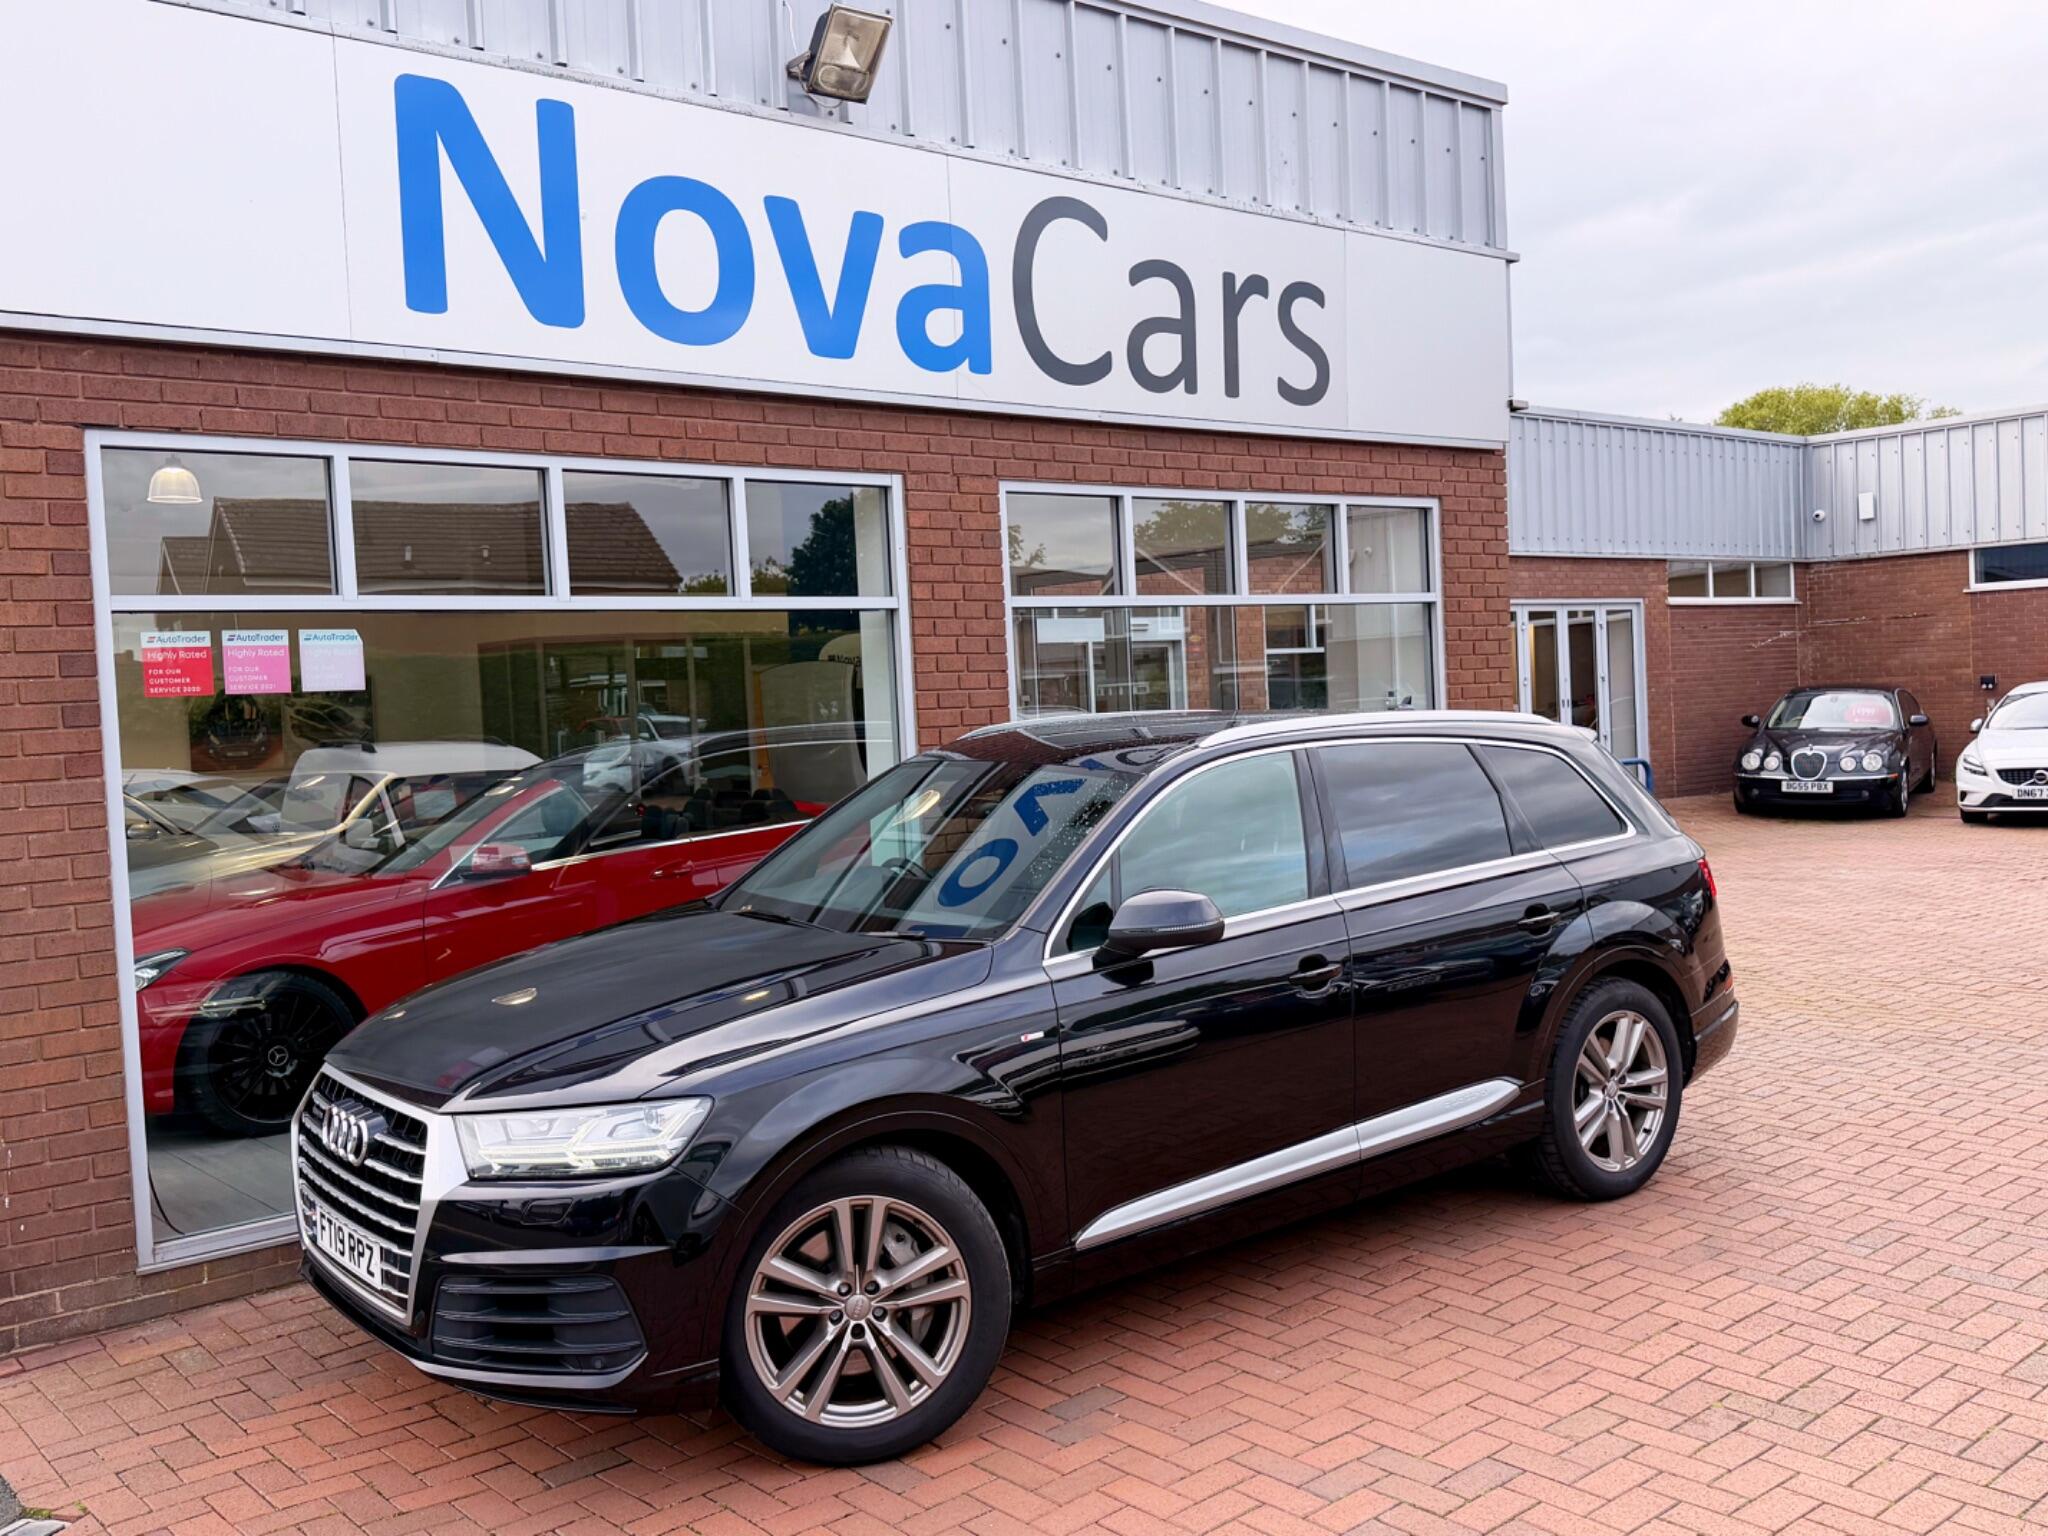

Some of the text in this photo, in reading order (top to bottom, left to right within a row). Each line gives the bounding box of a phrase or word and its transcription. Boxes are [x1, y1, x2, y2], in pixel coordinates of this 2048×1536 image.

[394, 73, 1330, 407] NovaCars
[156, 634, 206, 644] AutoTrader
[236, 633, 284, 642] AutoTrader
[312, 633, 358, 641] AutoTrader
[147, 650, 207, 661] Highly Rated
[227, 647, 285, 659] Highly Rated
[148, 677, 191, 685] CUSTOMER
[228, 674, 268, 682] CUSTOMER
[319, 1211, 376, 1278] FT19 RPZ
